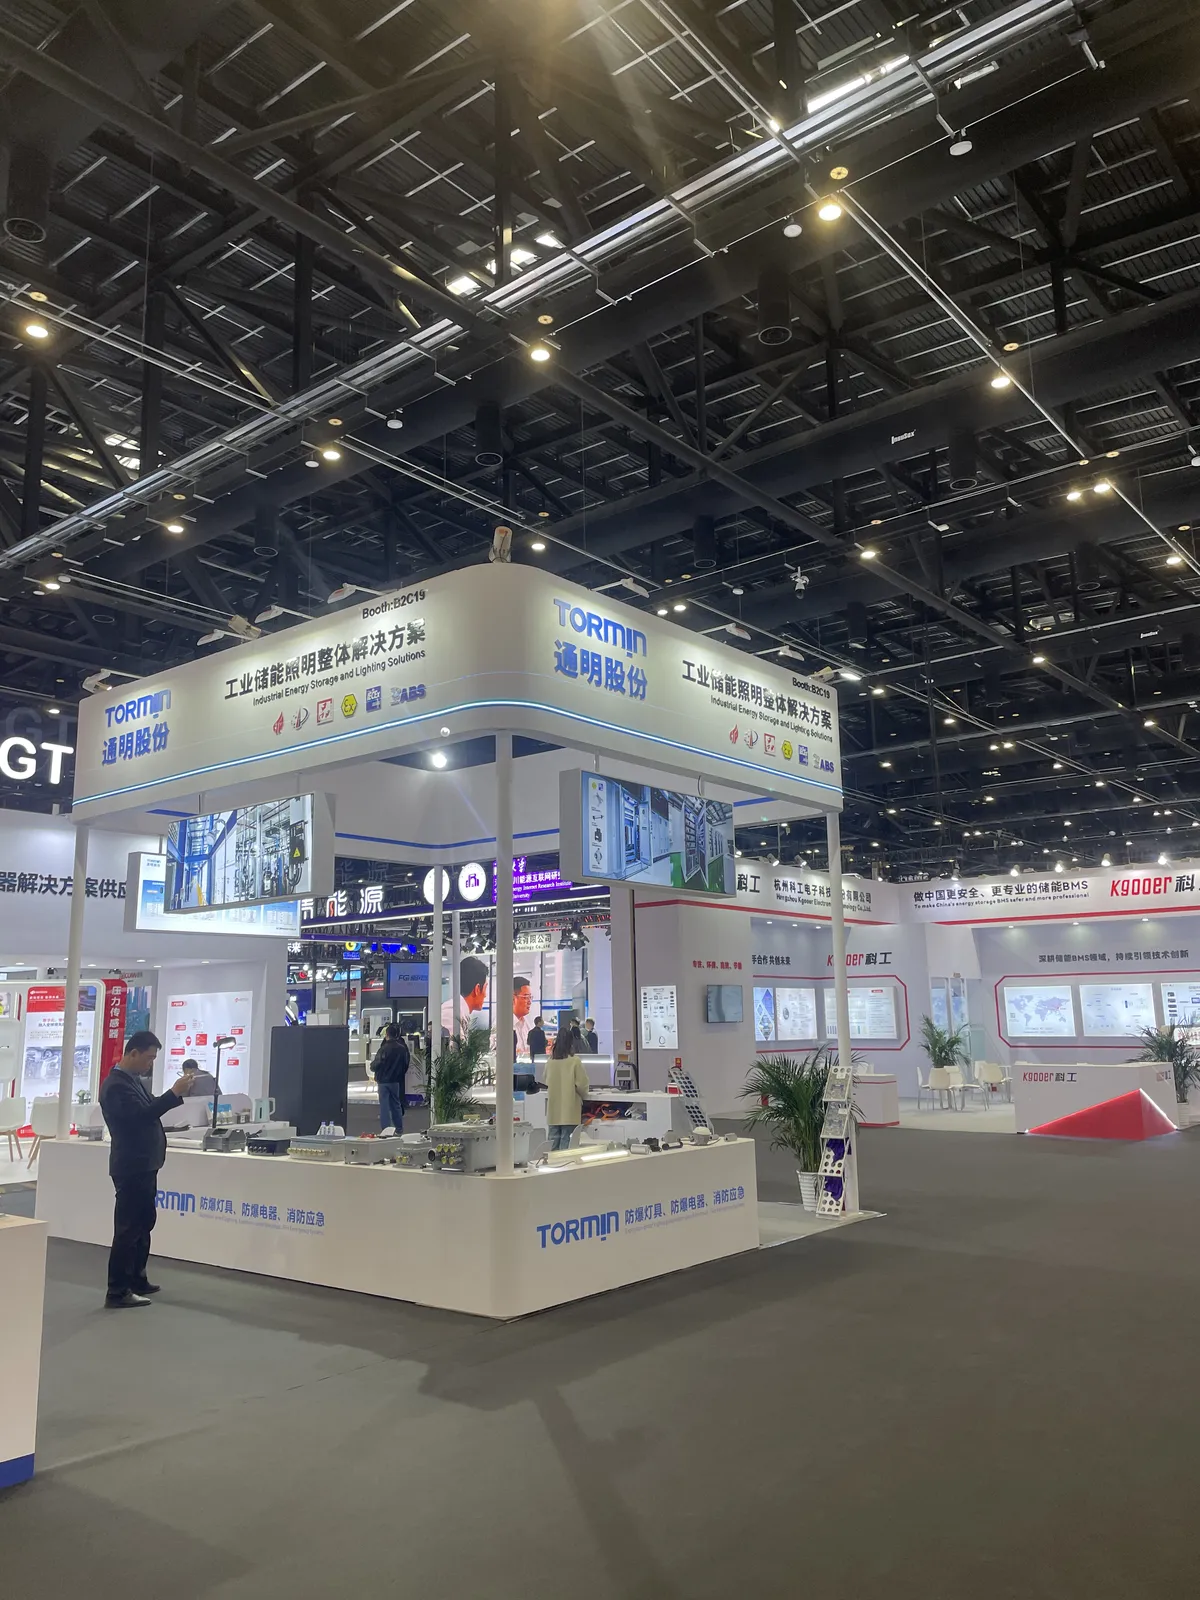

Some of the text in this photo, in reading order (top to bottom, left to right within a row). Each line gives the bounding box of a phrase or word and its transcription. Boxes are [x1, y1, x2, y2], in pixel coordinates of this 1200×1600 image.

[362, 591, 425, 619] Booth:B2C19
[225, 618, 425, 700] 工业储能照明整体解决方案
[554, 639, 647, 701] 通明股份
[253, 650, 425, 706] Industrial Energy Storage and Lighting Solutions
[400, 684, 426, 703] ABS
[682, 660, 832, 730] 工业储能照明整体解决方案
[710, 694, 833, 743] Industrial Energy Storage and Lighting Solutions
[0, 736, 74, 785] GT
[102, 722, 169, 766] 通明股份
[820, 758, 835, 773] ABS
[737, 873, 761, 893] 科工
[774, 878, 872, 904] 杭州科工电子科技有限公司
[914, 880, 1089, 902] 做中国更安全、更专业的储能BMS
[1174, 874, 1200, 892] 科
[826, 951, 892, 966] Koer 科工
[155, 1190, 196, 1217] RMIN
[200, 1196, 325, 1227] 防爆灯具、防爆电器、消防应急
[625, 1185, 745, 1225] 防爆灯具、防爆电器、消防应急
